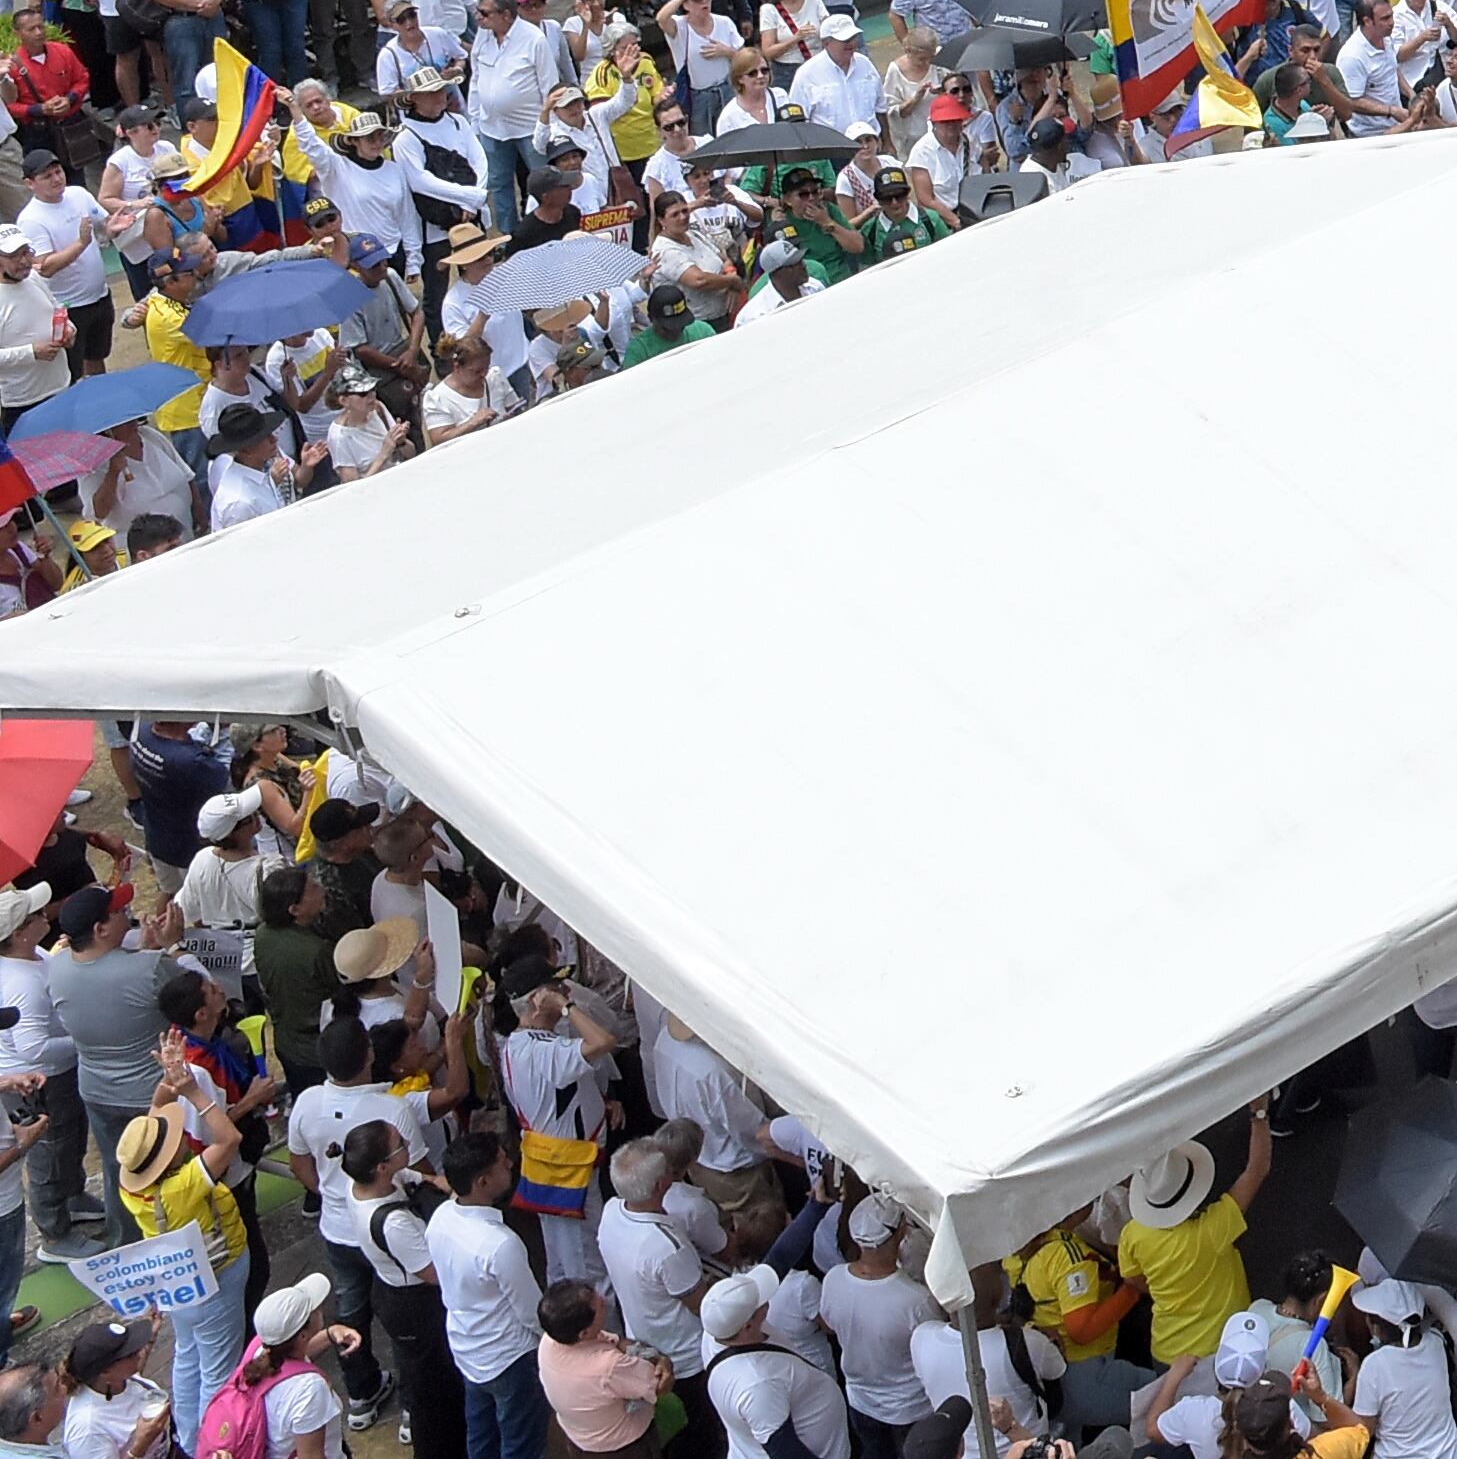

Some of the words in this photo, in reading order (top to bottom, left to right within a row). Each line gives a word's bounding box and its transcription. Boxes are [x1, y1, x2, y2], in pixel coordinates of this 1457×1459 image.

[87, 1253, 122, 1272] Soy
[95, 1248, 195, 1284] colombiano
[104, 1274, 156, 1297] estoy
[161, 1262, 199, 1284] con
[111, 1275, 207, 1316] Israel
